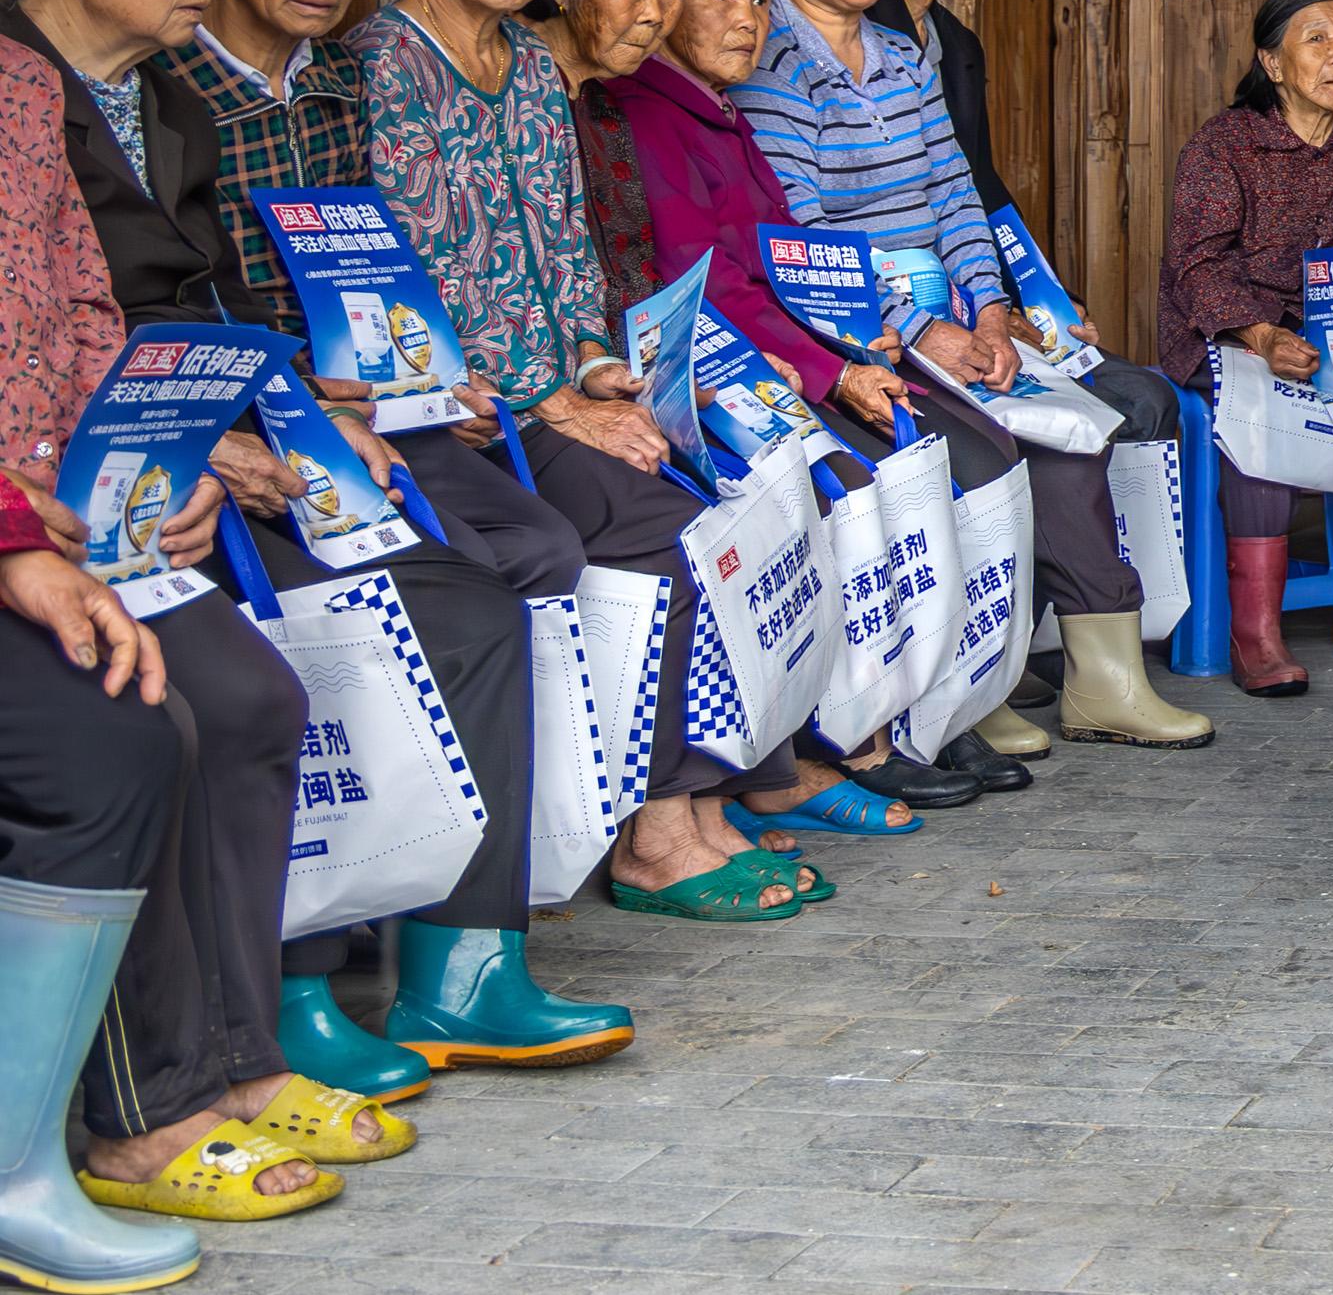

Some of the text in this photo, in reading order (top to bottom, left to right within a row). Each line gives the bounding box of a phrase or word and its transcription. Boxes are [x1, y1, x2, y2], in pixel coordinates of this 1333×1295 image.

[279, 204, 388, 231] 闽盐 低钠盐
[288, 232, 401, 254] 关注心脑血管健康
[994, 224, 1019, 249] 盐
[774, 242, 807, 263] 闽盐
[808, 243, 862, 269] 低钠盐
[774, 266, 866, 288] 关注心脑血管健康
[127, 344, 268, 379] 闽盐 低钠盐
[104, 379, 247, 404] 关注心脑血管健康
[745, 526, 811, 614] 不添加抗结剂
[757, 564, 823, 651] 吃好盐选闽盐
[304, 813, 332, 826] FUJIAN
[333, 811, 349, 822] SALT
